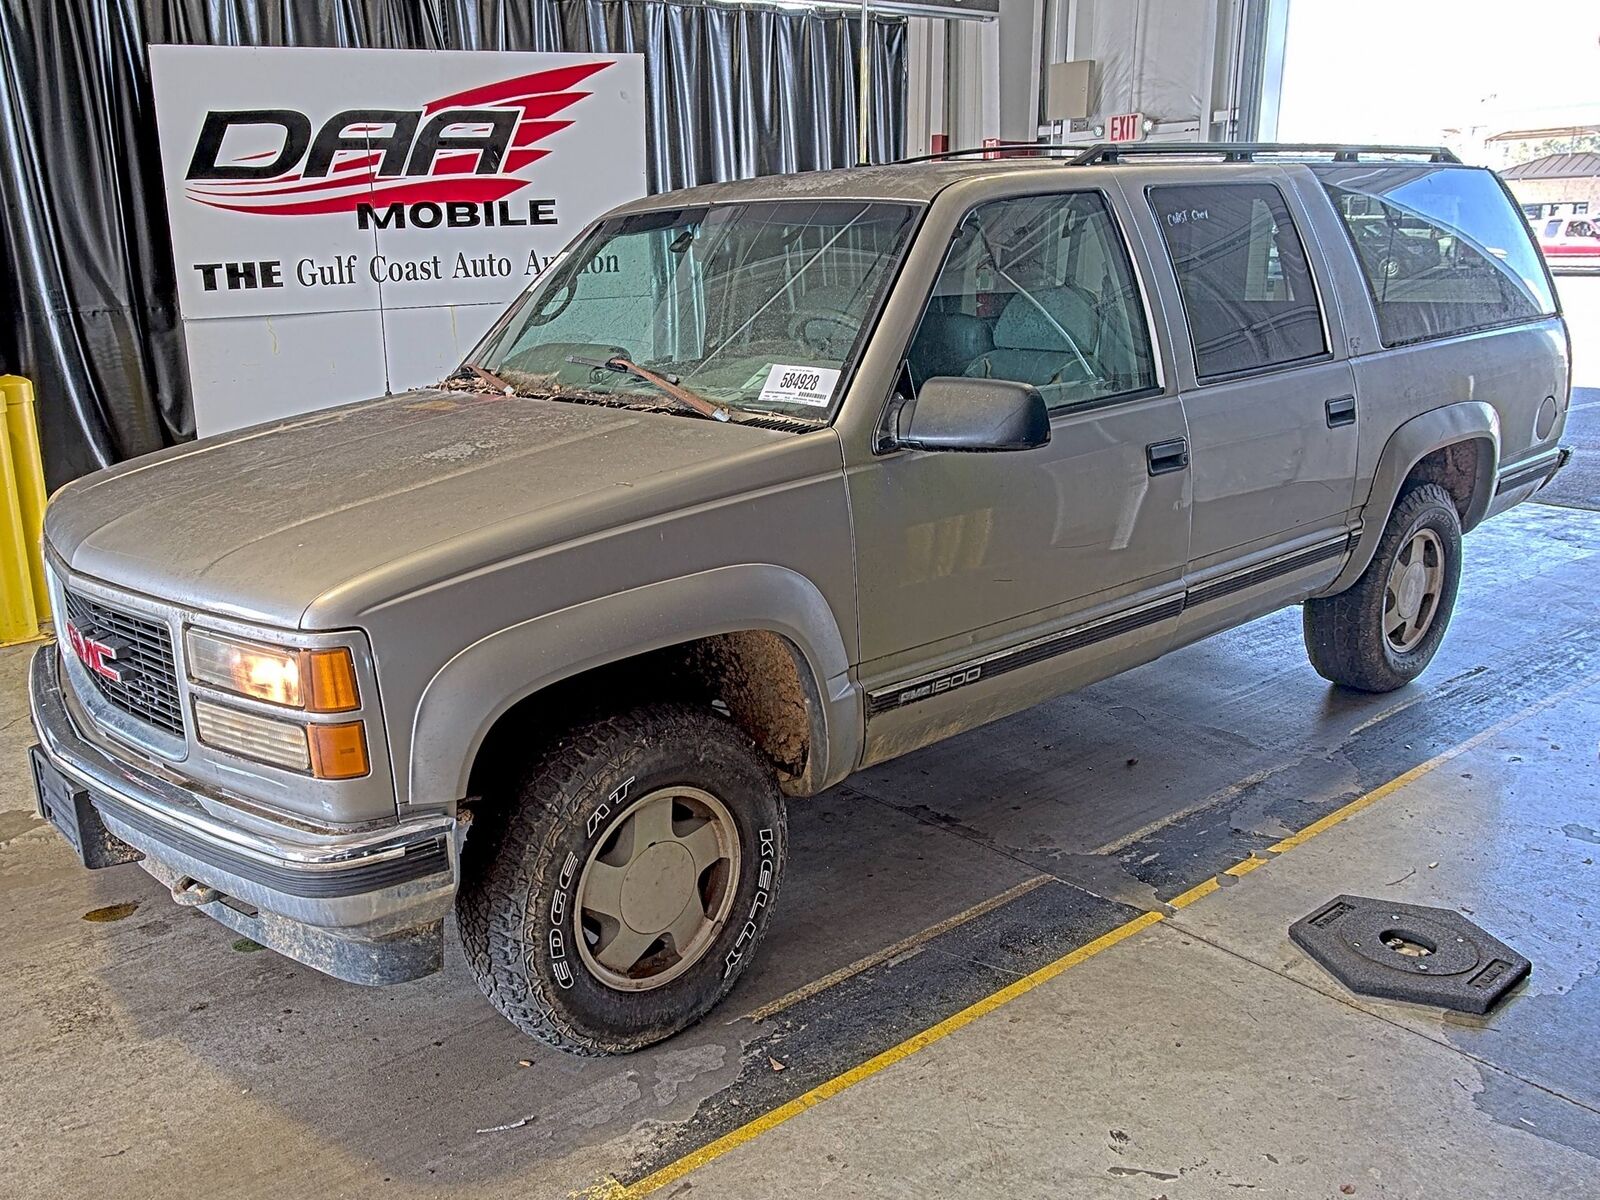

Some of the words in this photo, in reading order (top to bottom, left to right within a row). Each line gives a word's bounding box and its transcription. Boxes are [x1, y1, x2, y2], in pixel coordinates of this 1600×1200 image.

[185, 109, 522, 180] DAA
[1110, 115, 1138, 142] EXIT
[357, 199, 558, 230] MOBILE
[193, 260, 283, 291] THE
[296, 255, 357, 287] Gulf
[370, 250, 442, 283] Coast
[452, 247, 512, 279] Auto
[780, 372, 820, 391] 584928
[67, 621, 122, 684] GMC
[931, 666, 981, 693] 1500
[549, 851, 579, 989] EDGE
[586, 776, 636, 839] AT
[723, 828, 775, 979] KELLY
